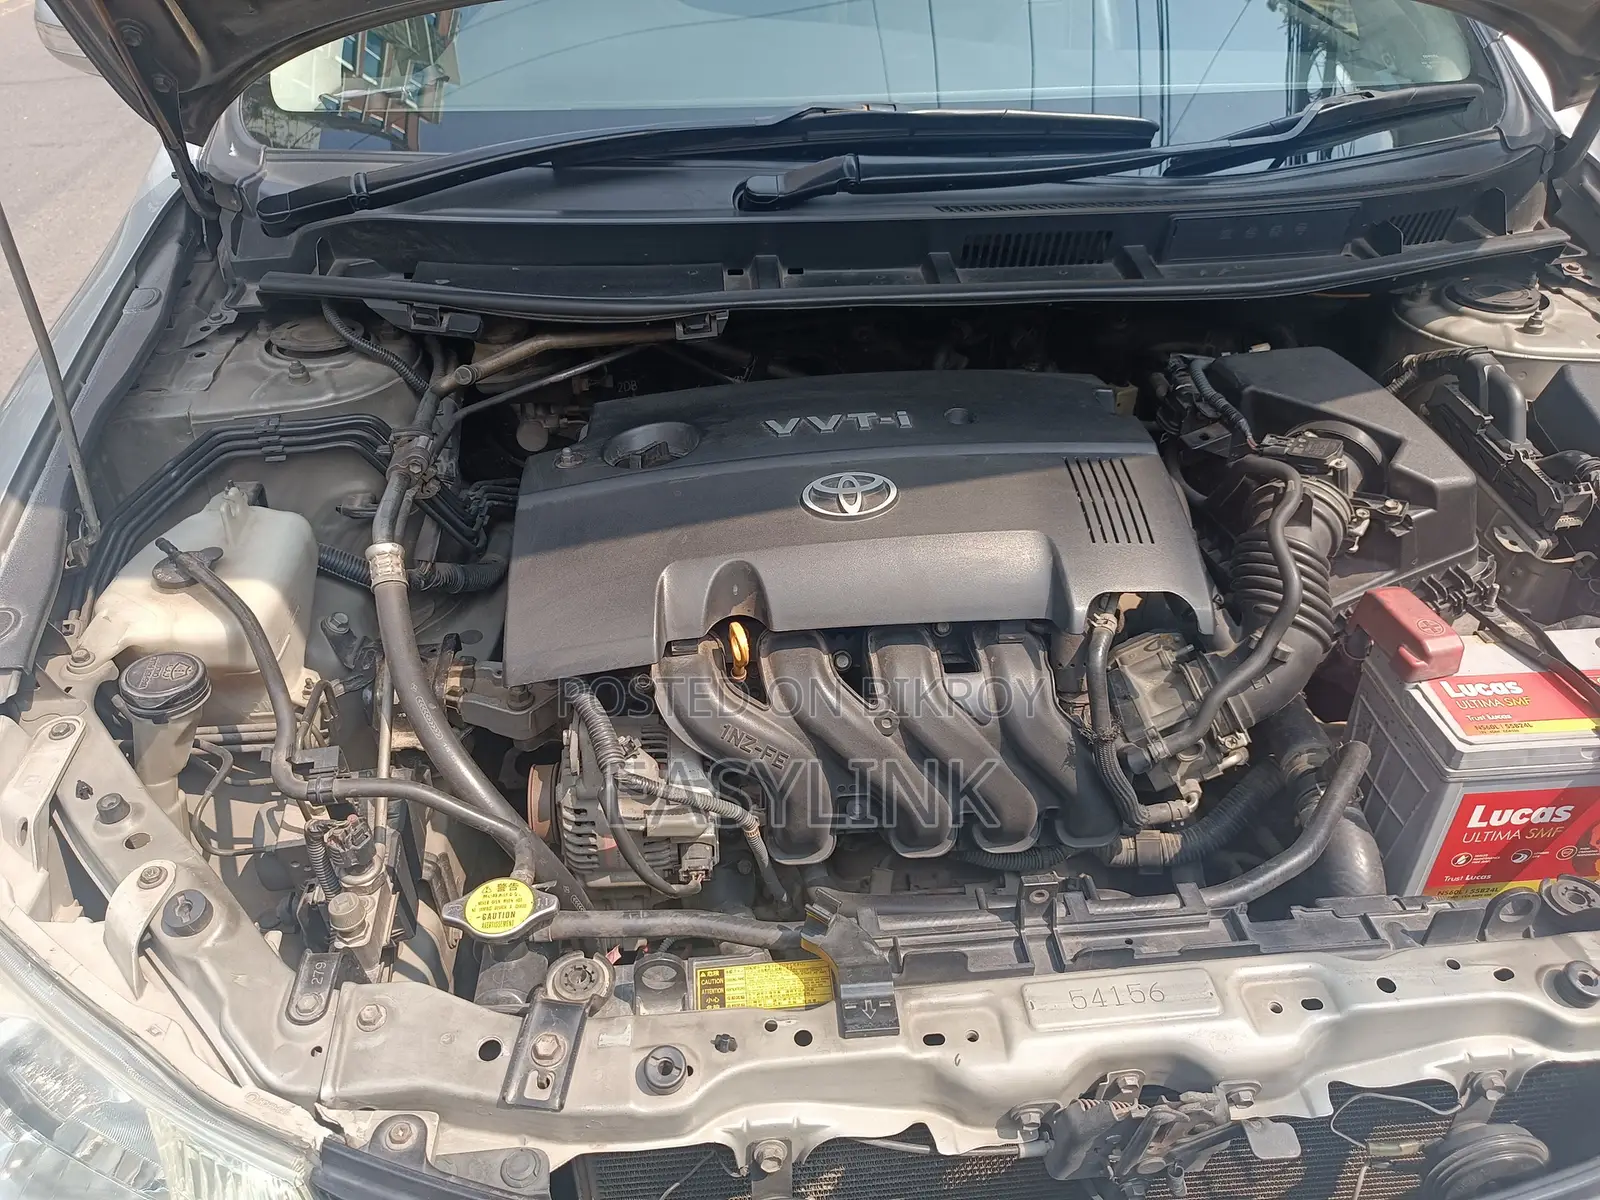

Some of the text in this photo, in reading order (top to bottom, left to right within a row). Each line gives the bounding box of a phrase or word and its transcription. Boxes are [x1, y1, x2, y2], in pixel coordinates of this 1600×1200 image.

[1439, 680, 1524, 699] Lucas
[1455, 696, 1532, 710] ULTIMA SMF
[1466, 713, 1513, 722] Trust Lucas
[719, 722, 791, 770] 1NZ-FE
[1467, 804, 1575, 829] Lucas
[1462, 826, 1565, 844] ULTIMA SMF
[482, 911, 516, 921] CAUTION
[311, 962, 327, 985] 279
[701, 978, 724, 986] CAUTION
[1068, 981, 1166, 1010] 54156
